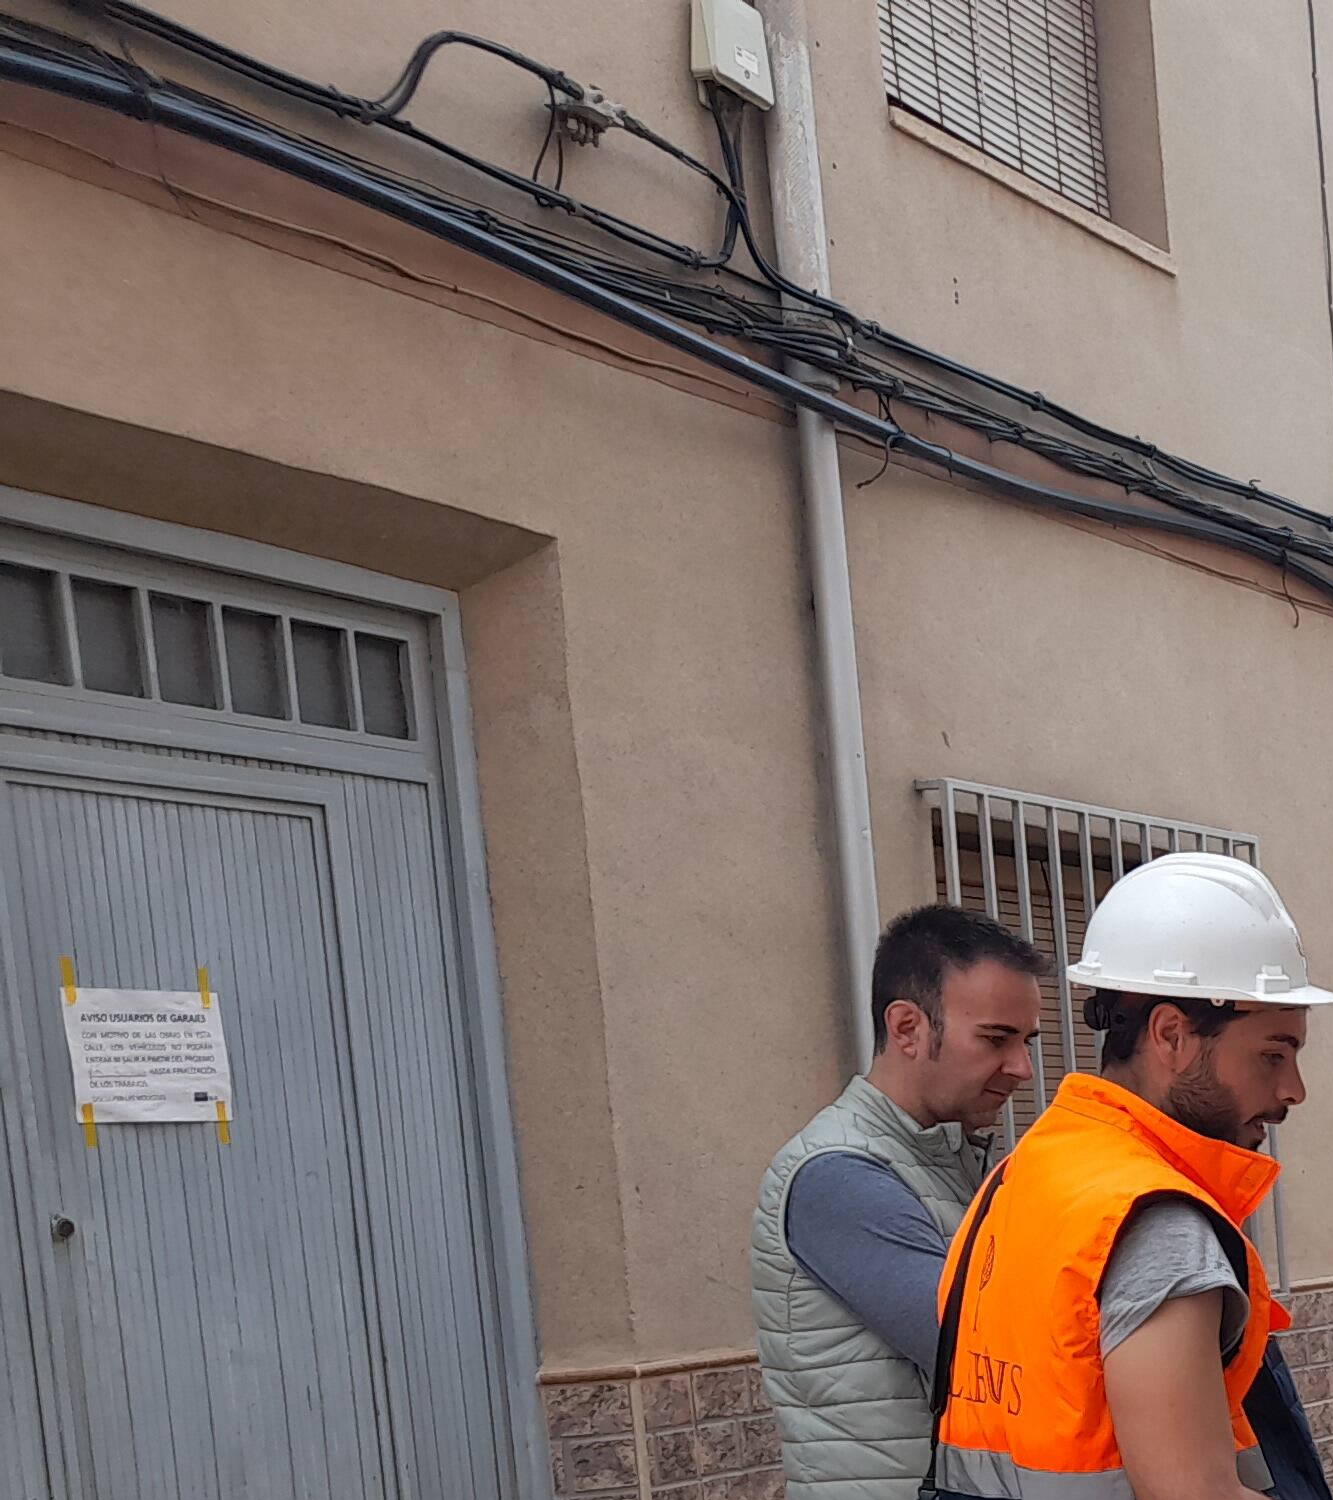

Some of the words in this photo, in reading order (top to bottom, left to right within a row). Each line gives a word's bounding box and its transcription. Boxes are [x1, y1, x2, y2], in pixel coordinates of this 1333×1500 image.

[81, 1013, 108, 1023] AVISO
[109, 1013, 154, 1023] USUARIOS
[156, 1013, 167, 1023] DE
[170, 1013, 207, 1024] GARAJES
